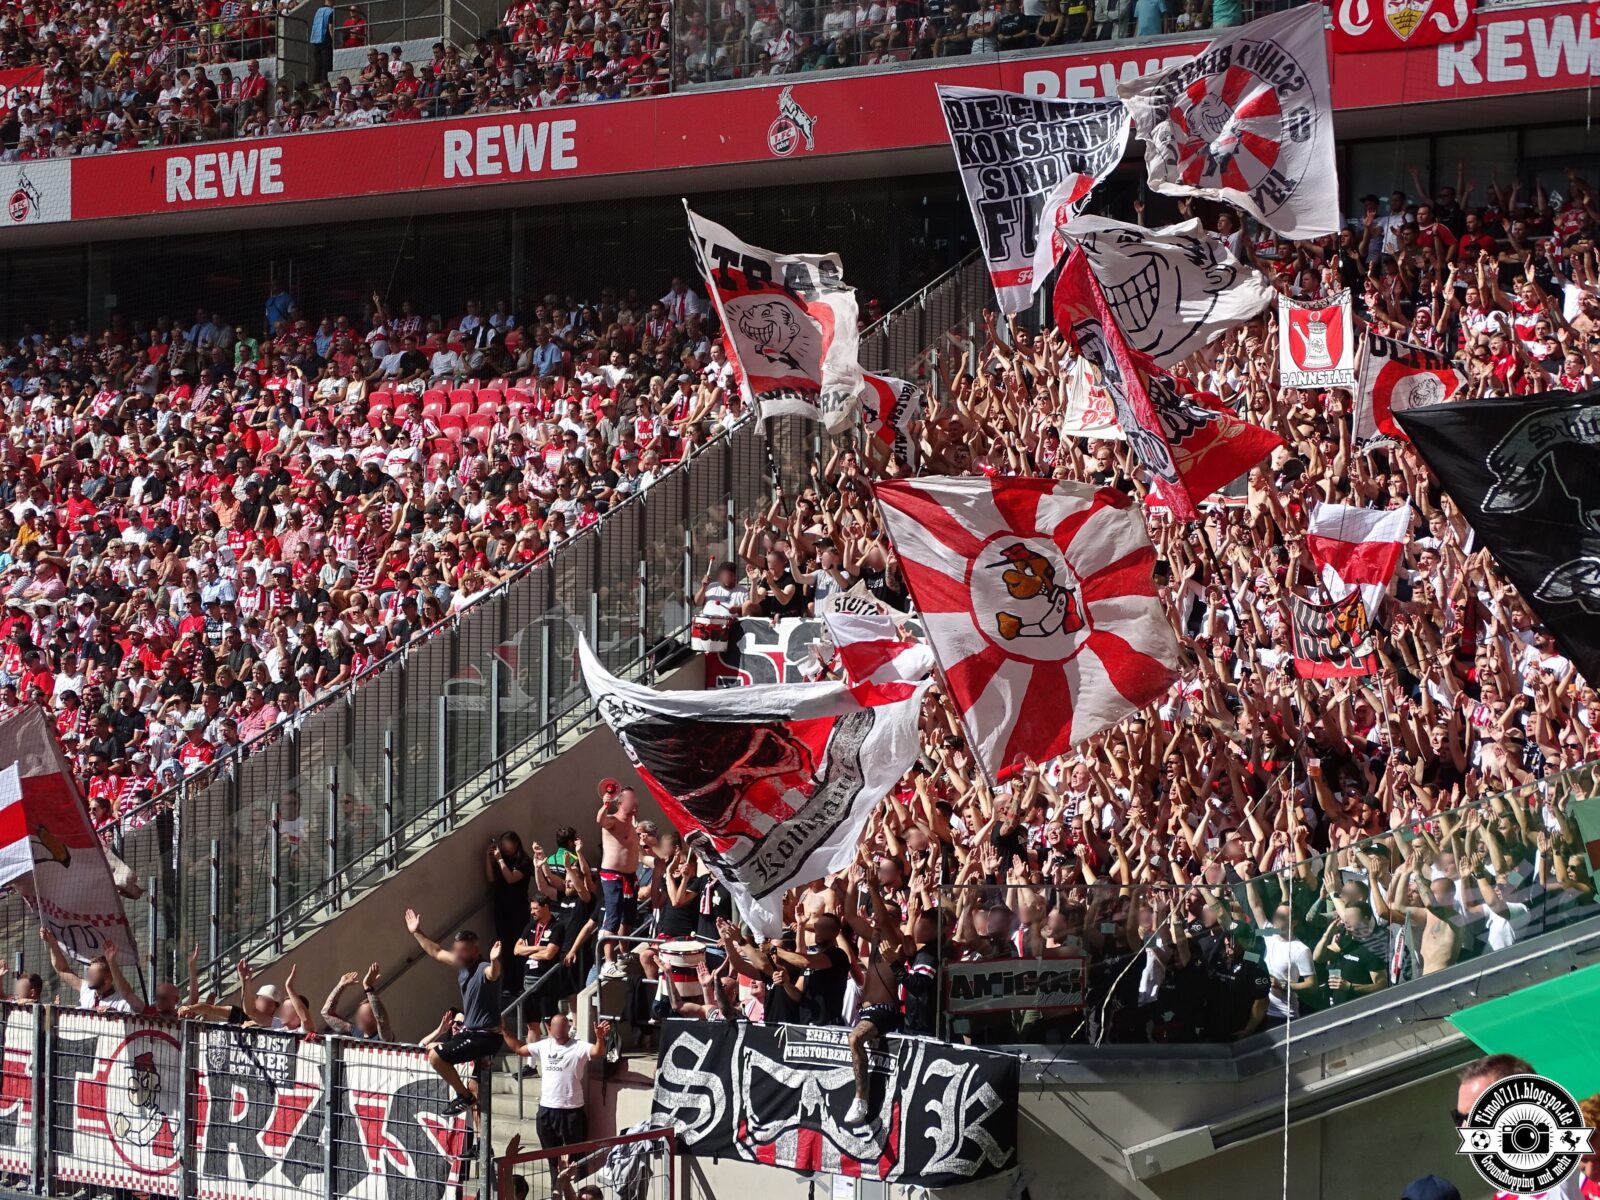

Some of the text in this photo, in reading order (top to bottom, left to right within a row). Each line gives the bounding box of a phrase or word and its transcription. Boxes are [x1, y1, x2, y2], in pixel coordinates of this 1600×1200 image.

[1438, 12, 1600, 87] REW
[945, 99, 1005, 131] DIE
[443, 118, 578, 179] REWE
[166, 146, 284, 203] REWE
[981, 156, 1059, 200] SIND
[257, 1034, 292, 1053] BIST
